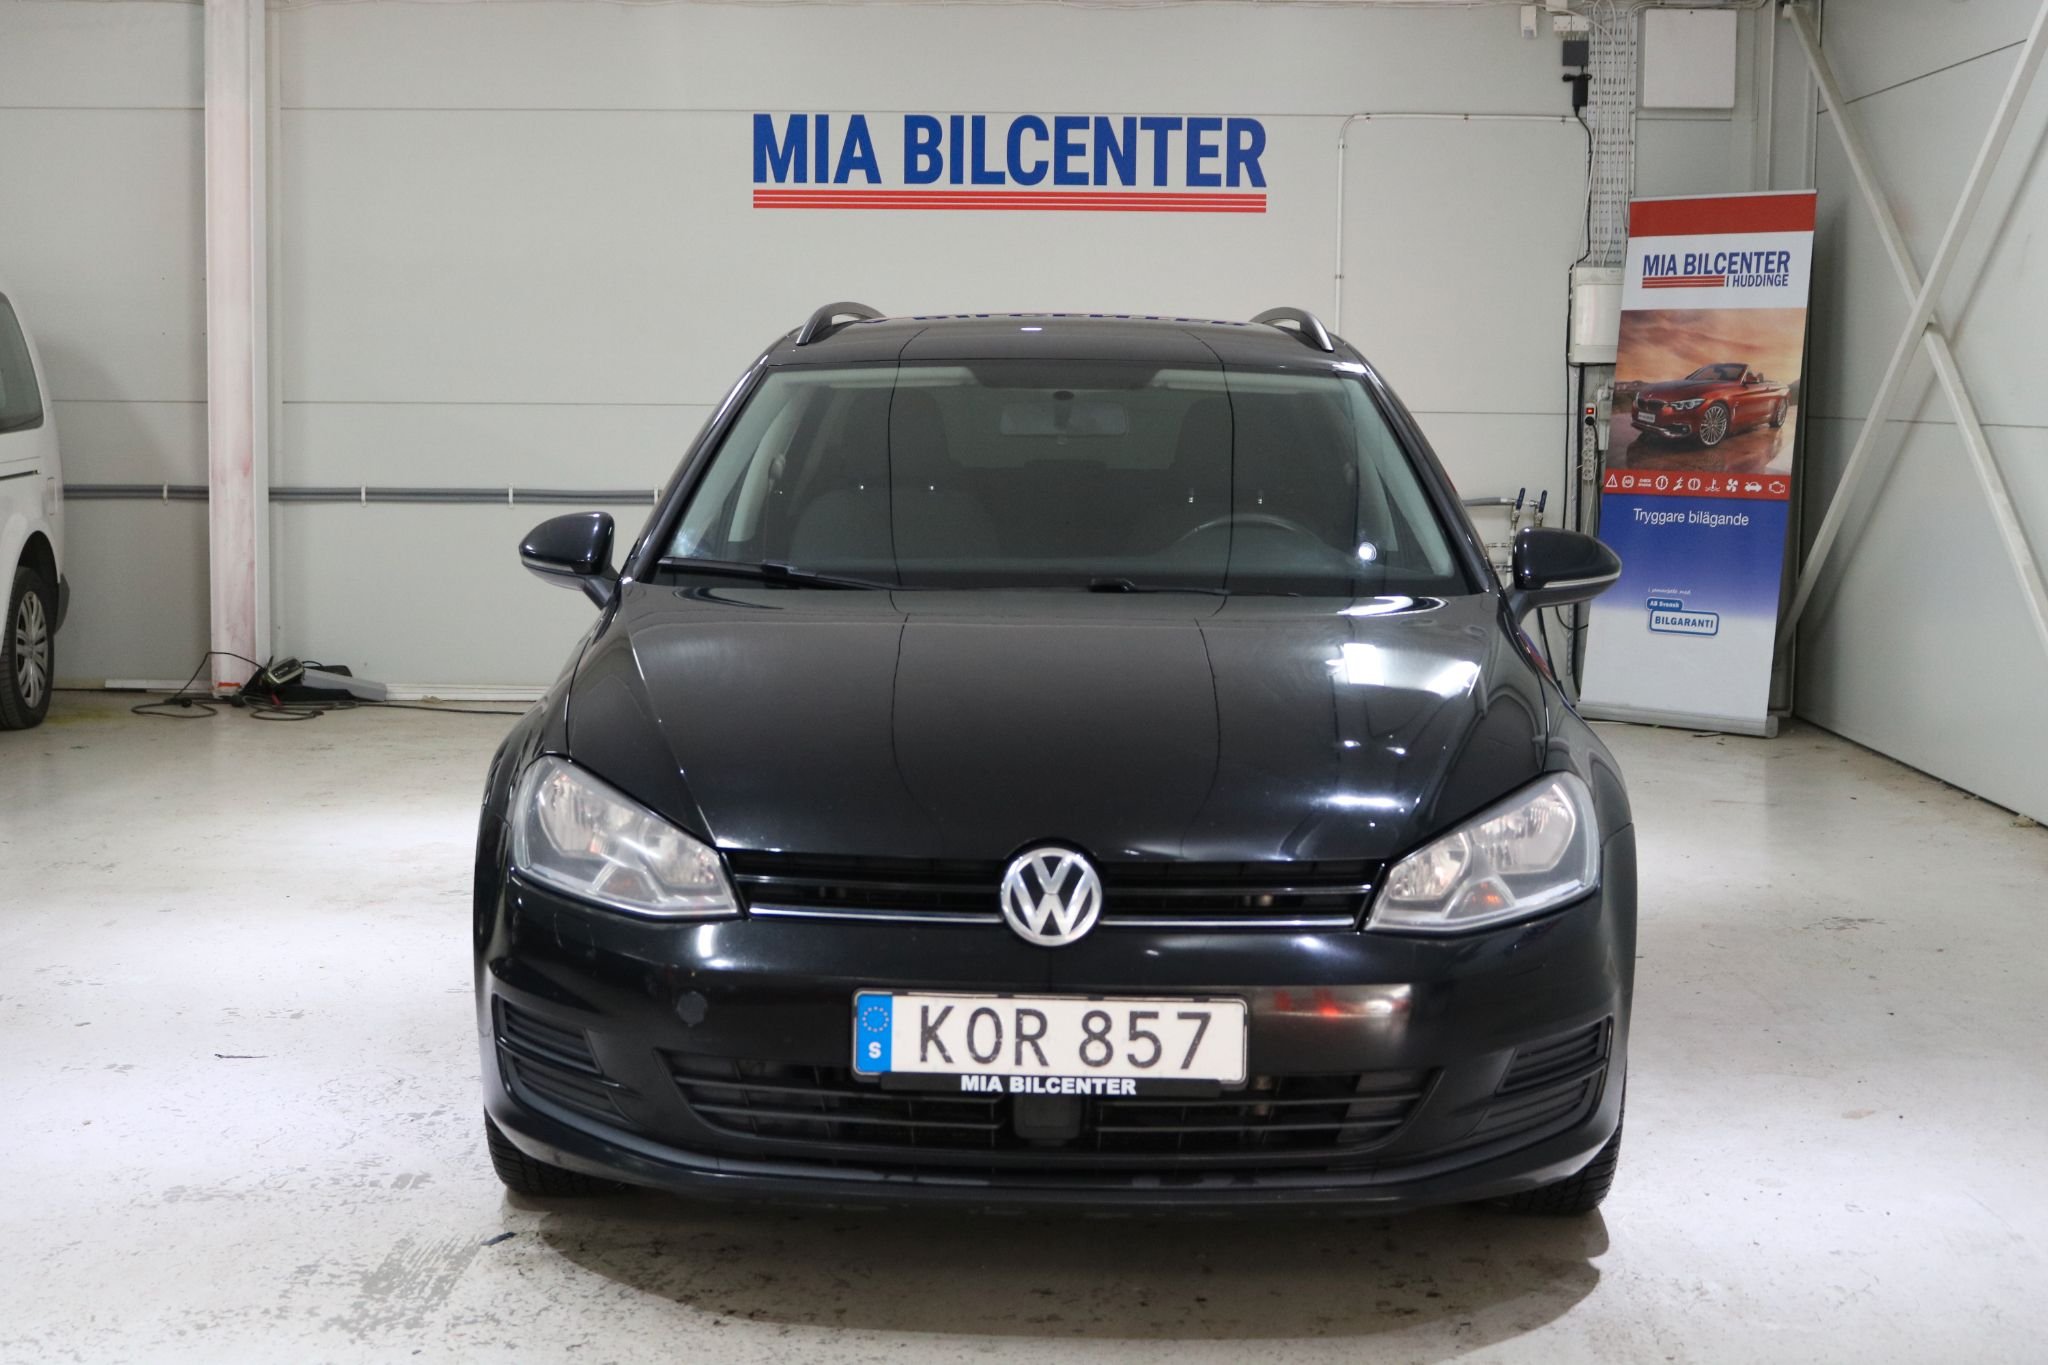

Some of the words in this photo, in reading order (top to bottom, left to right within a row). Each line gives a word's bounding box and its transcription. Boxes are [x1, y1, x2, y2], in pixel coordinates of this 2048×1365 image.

[753, 114, 882, 183] MIA
[904, 115, 1267, 187] BILCENTER
[1642, 254, 1677, 276] MIA
[1683, 250, 1791, 275] BILCENTER
[1732, 274, 1789, 288] HUDDINGE
[1633, 508, 1685, 525] Tryggare
[1688, 510, 1749, 528] bilägande
[1655, 615, 1714, 629] BILGARANTI
[919, 1005, 1049, 1067] KOR
[1078, 1010, 1212, 1070] 857
[868, 1041, 881, 1059] S
[961, 1075, 1003, 1093] MIA
[1009, 1076, 1137, 1095] BILCENTER
